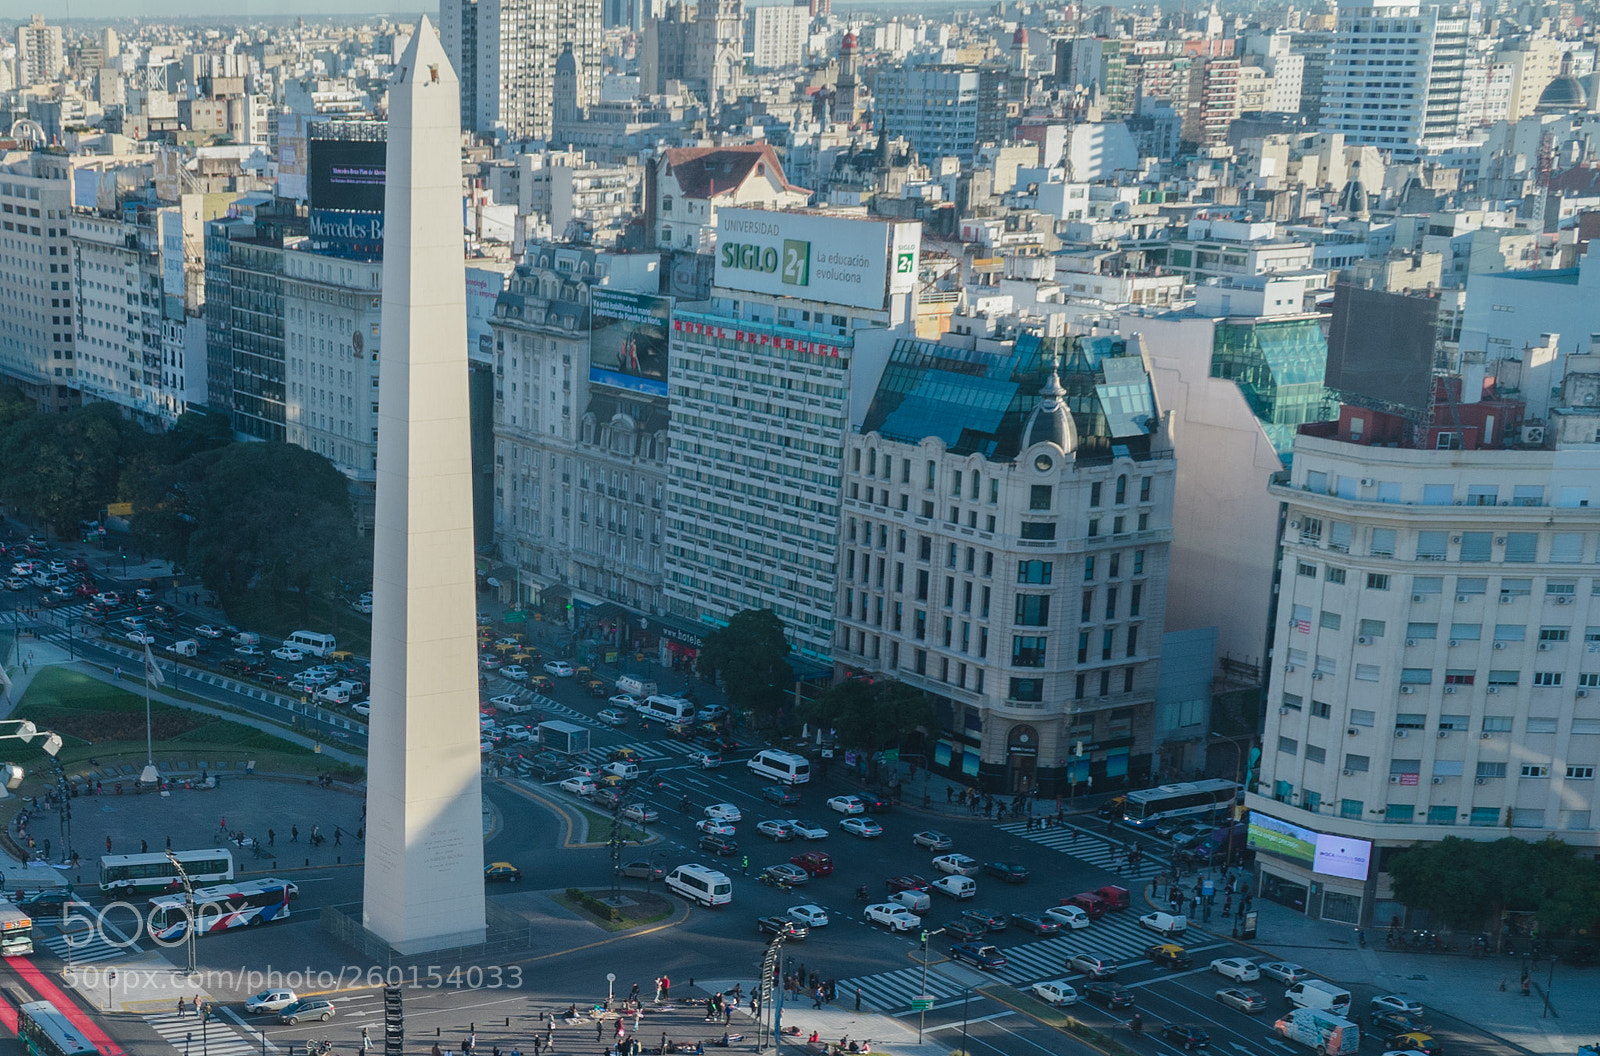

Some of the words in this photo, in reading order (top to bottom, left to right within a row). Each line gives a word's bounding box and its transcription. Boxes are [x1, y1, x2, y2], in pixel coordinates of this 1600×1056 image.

[724, 219, 780, 236] UNIVERSIDAD
[722, 242, 778, 274] SIGLO
[784, 249, 805, 285] 21
[816, 252, 826, 263] La
[828, 252, 870, 268] educación
[898, 256, 912, 272] 21
[816, 268, 862, 284] evoluciona
[674, 320, 725, 338] HOTEL
[736, 330, 839, 358] REPUBLICA
